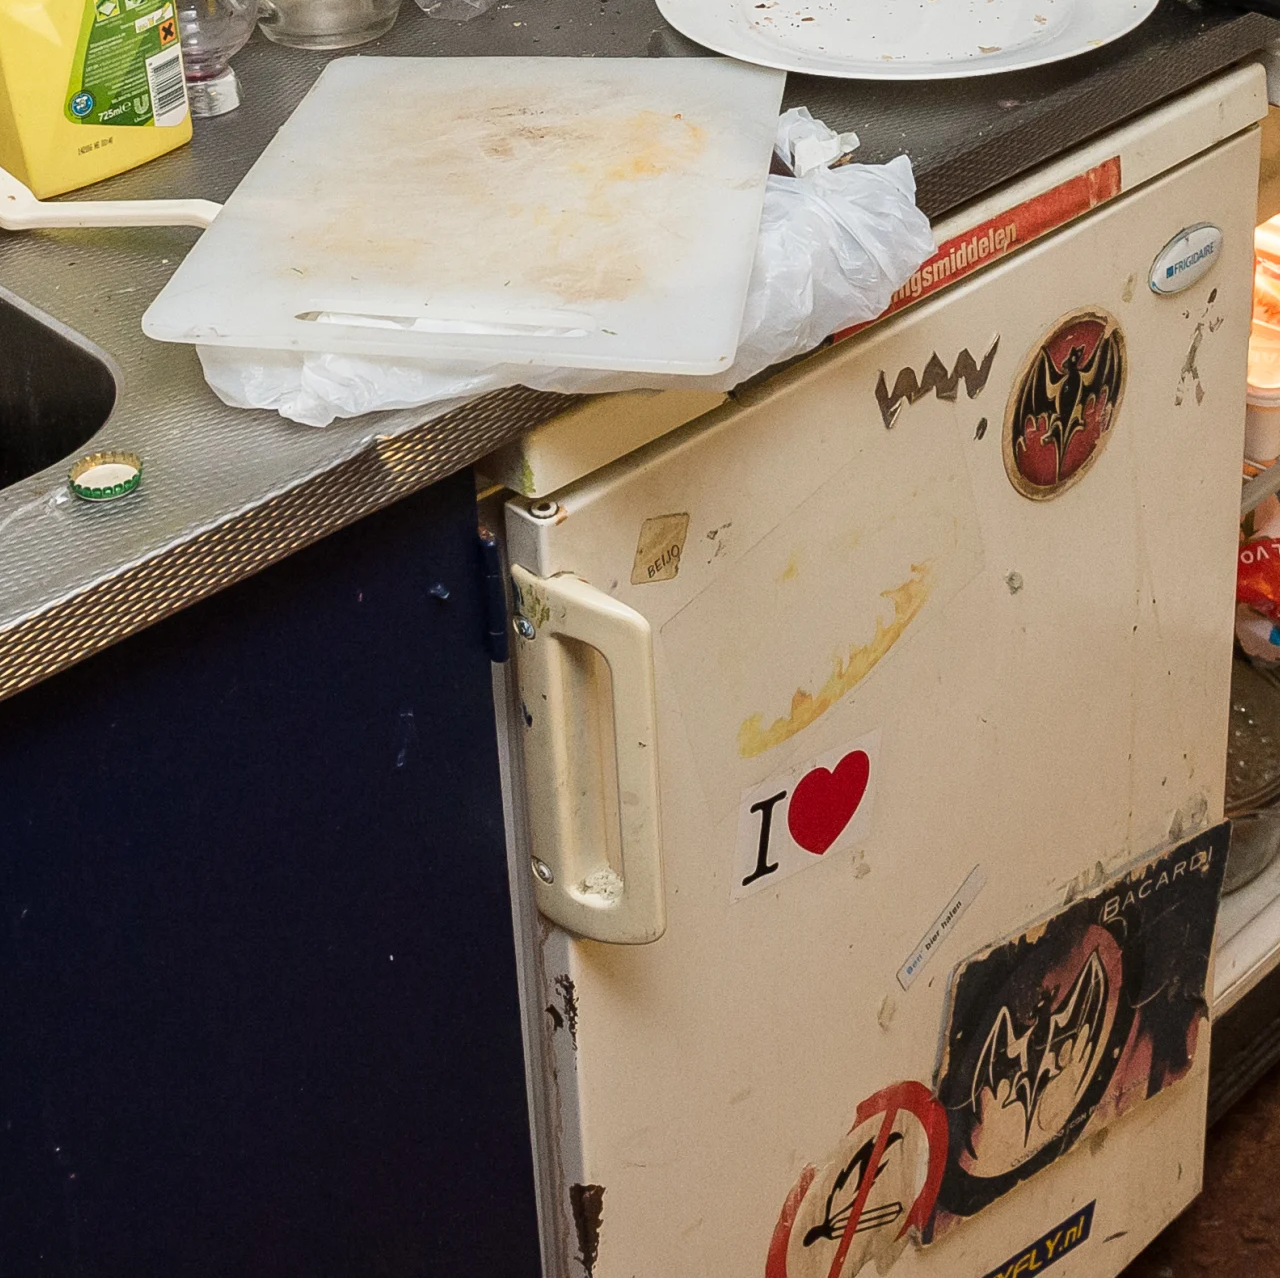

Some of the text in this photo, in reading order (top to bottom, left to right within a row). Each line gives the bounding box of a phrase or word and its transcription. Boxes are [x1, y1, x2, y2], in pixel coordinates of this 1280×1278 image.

[1173, 241, 1215, 275] FRIGIDAIRE
[741, 790, 788, 887] I
[1102, 845, 1213, 922] BACARDI
[925, 929, 940, 951] bier
[940, 900, 963, 930] halen
